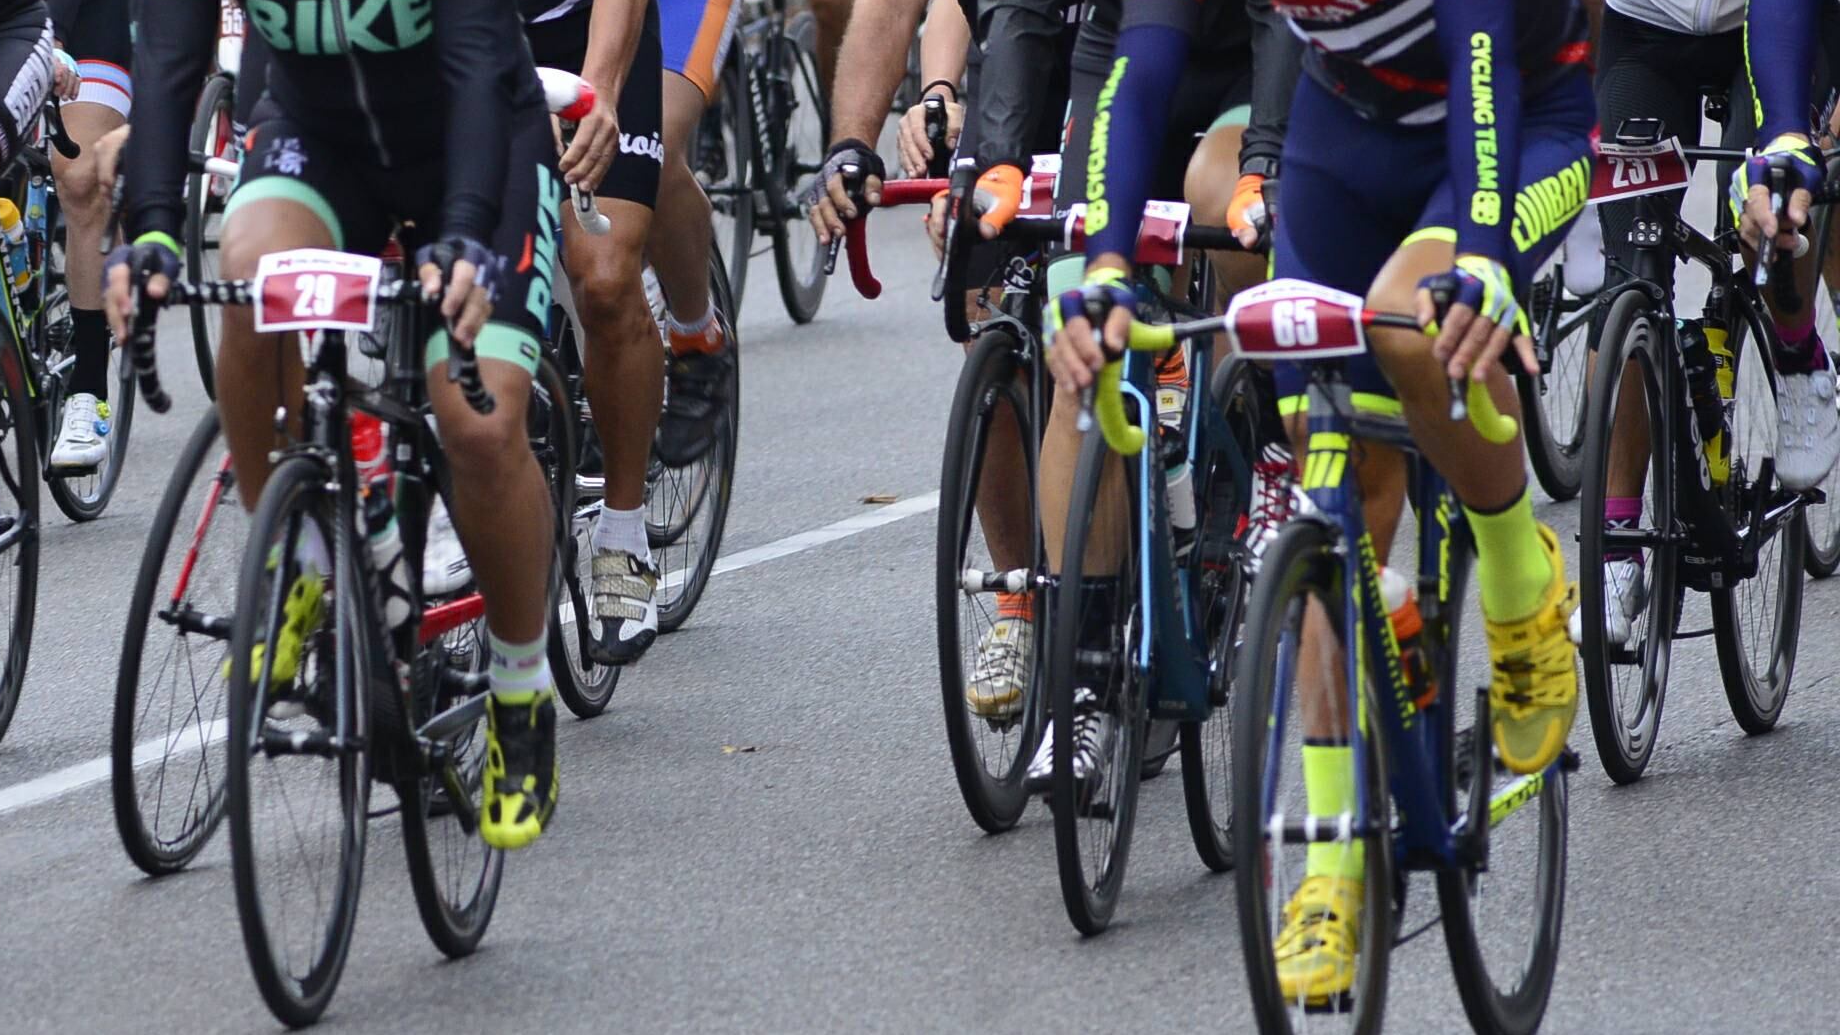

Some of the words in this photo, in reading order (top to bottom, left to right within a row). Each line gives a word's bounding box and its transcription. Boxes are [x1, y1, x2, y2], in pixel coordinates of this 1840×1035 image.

[1470, 31, 1498, 126] CYCLING
[1474, 127, 1500, 190] TEAM
[1607, 155, 1660, 189] 231
[525, 162, 561, 335] BIKE
[292, 273, 337, 318] 29
[1271, 298, 1319, 348] 65
